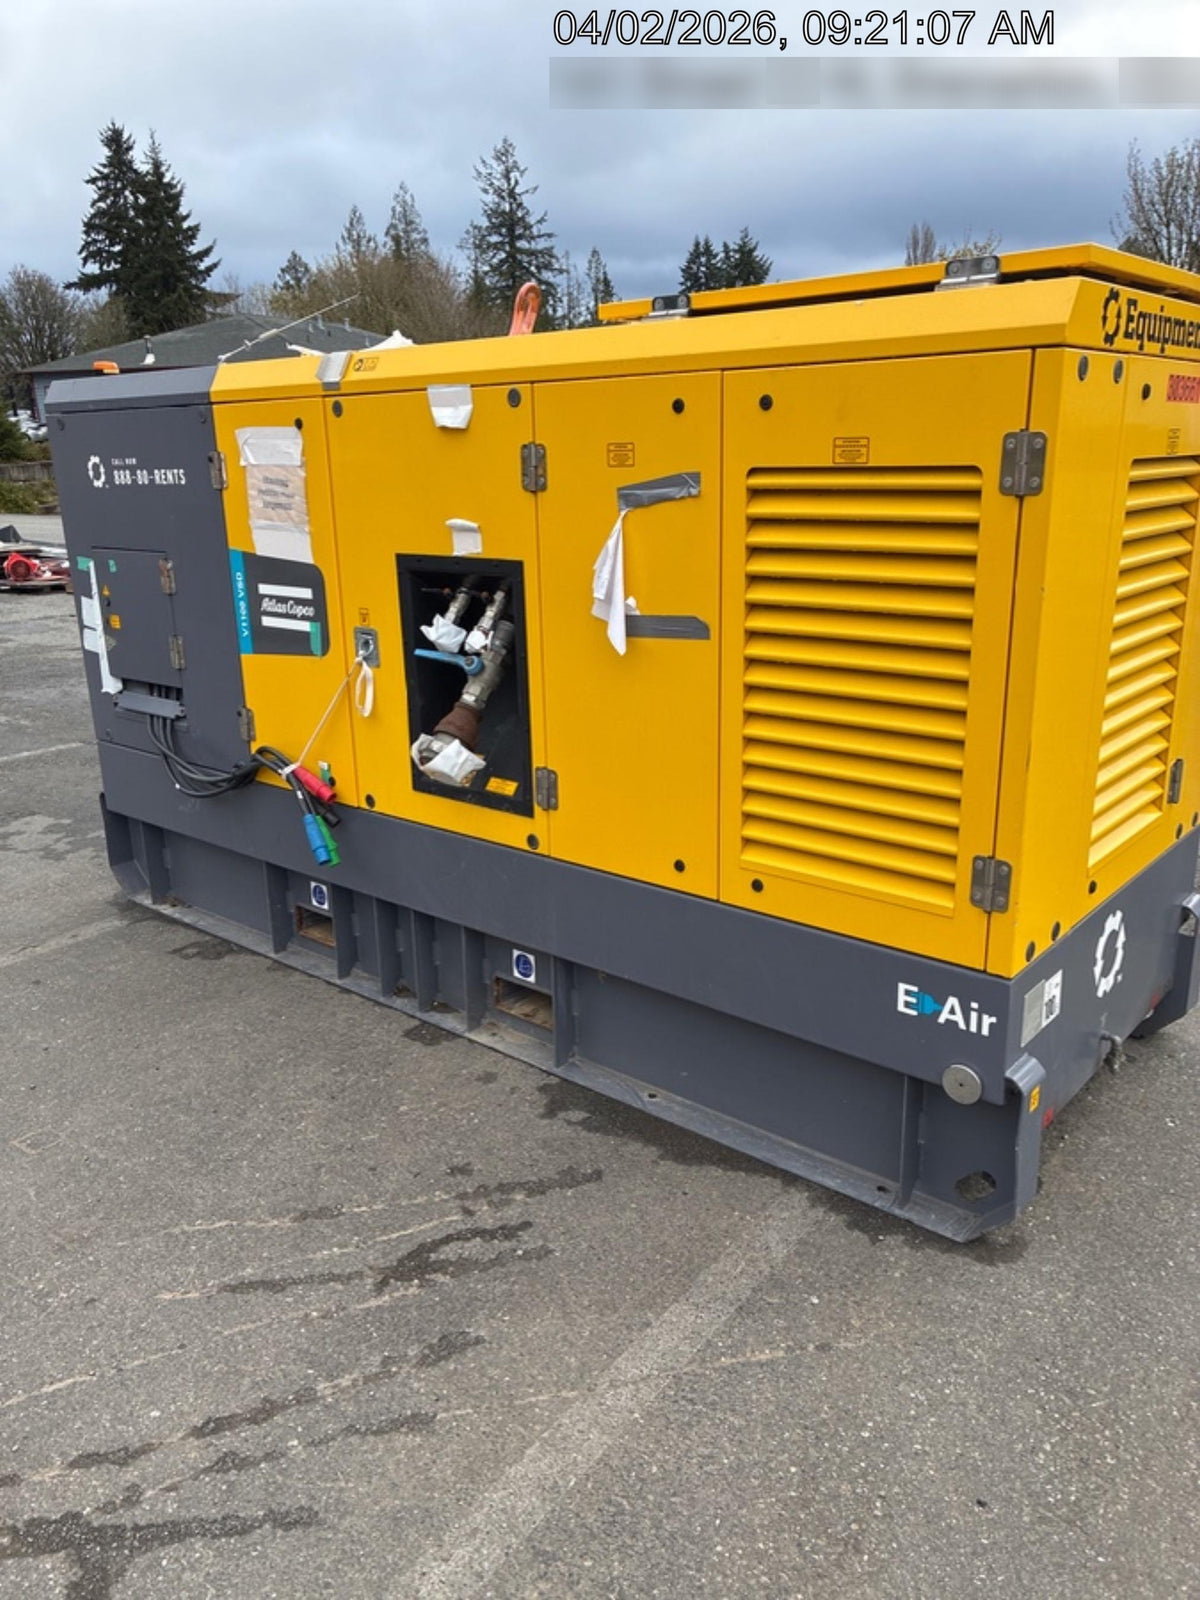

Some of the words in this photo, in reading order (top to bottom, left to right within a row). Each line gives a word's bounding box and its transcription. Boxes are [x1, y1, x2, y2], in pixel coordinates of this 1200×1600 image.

[113, 468, 186, 485] 888-80-RENTS
[235, 571, 245, 598] VSD
[260, 597, 287, 614] Atlas
[287, 600, 316, 618] Copco
